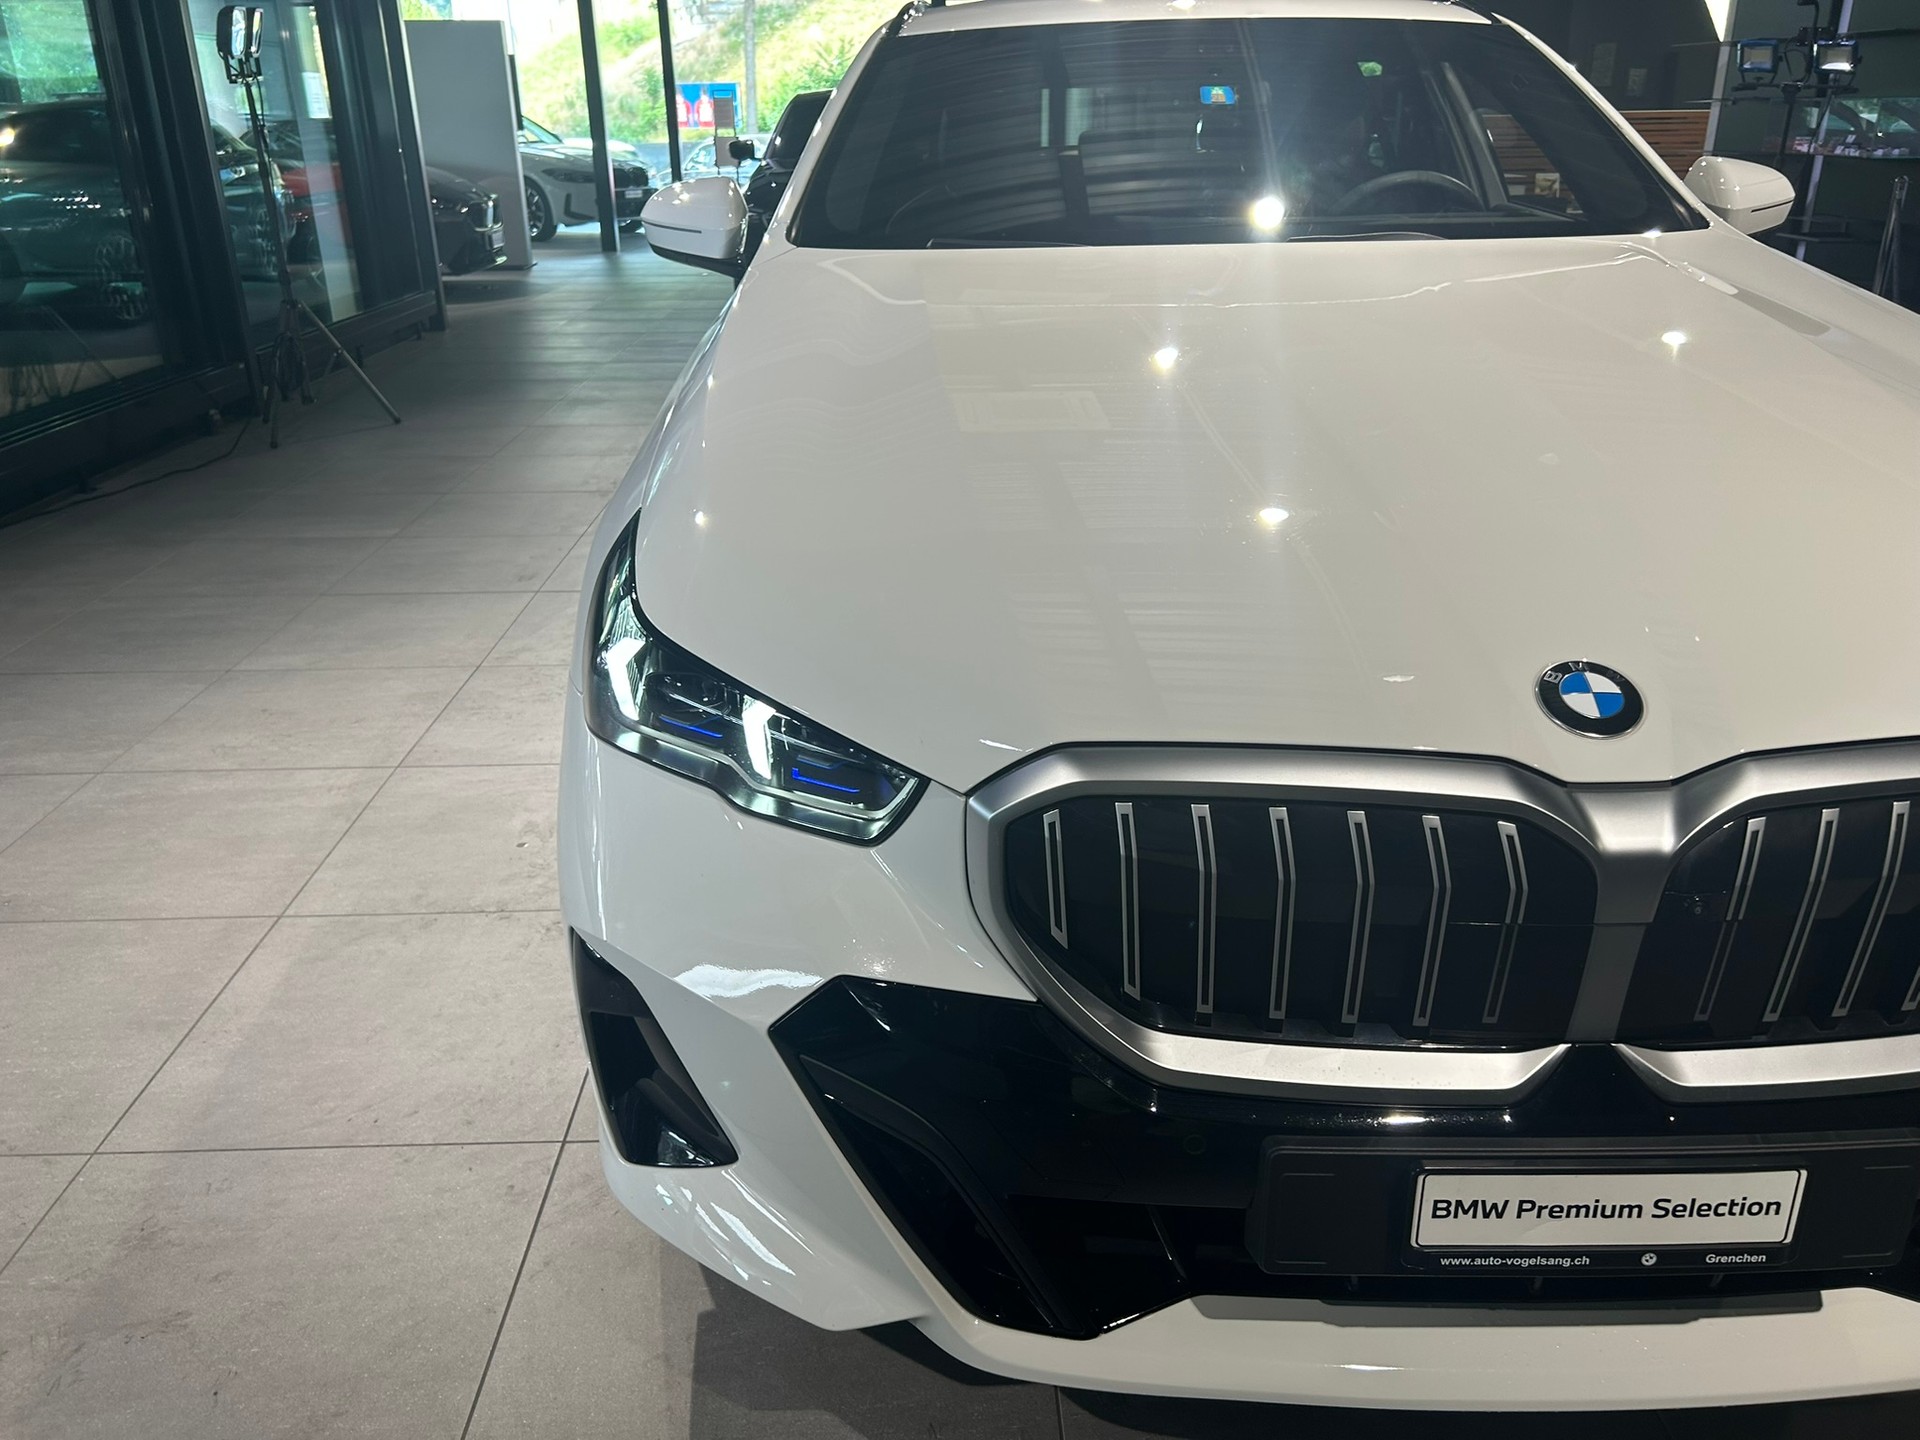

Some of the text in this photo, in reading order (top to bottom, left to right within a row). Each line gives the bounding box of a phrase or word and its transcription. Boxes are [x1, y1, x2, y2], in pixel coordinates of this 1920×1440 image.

[1430, 1197, 1782, 1220] BMW Premium Selection
[1440, 1256, 1590, 1268] www.auto-vogelsang.ch
[1705, 1253, 1767, 1264] Grenchen
